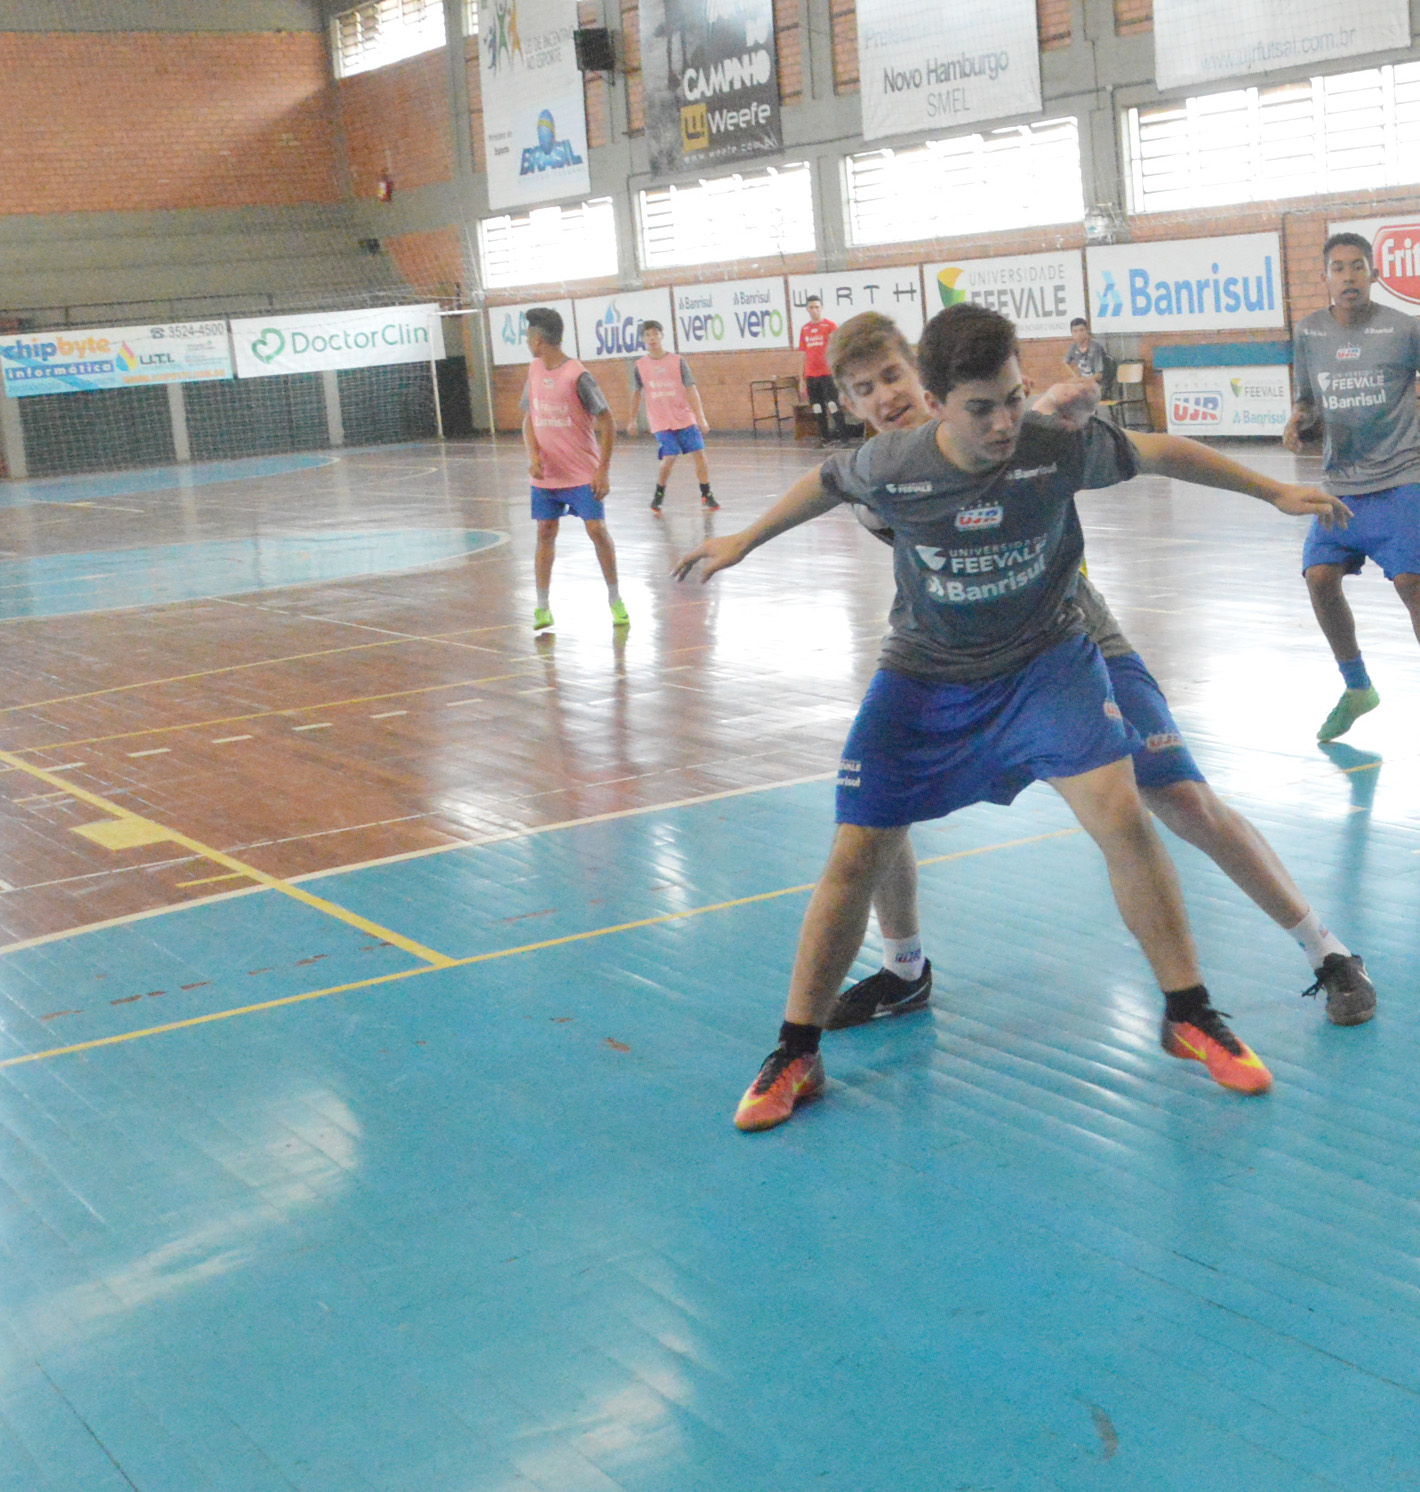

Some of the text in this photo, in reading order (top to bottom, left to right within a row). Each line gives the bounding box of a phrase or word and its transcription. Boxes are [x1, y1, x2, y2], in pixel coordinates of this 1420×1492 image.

[683, 49, 771, 101] CAMPINHO
[883, 50, 1010, 95] Novo Hamburgo
[926, 87, 971, 118] SMEL
[708, 102, 771, 135] Weefe
[969, 263, 1066, 287] UNIVERSIDADE
[1128, 255, 1275, 317] Banrisul
[685, 293, 713, 311] Banrisul
[738, 288, 771, 305] Banrisul
[970, 284, 1068, 320] FEEVALE
[167, 322, 225, 339] 3524-4500
[678, 312, 725, 342] vero
[733, 308, 784, 338] vero
[1, 336, 111, 362] chipbyte
[290, 322, 429, 355] DoctorClin
[7, 362, 112, 380] informática
[1331, 374, 1385, 391] FEEVALE
[1243, 385, 1285, 398] FEEVALE
[1328, 388, 1387, 410] Banrisul
[1173, 396, 1220, 422] UJR
[1242, 409, 1286, 424] Banrisul
[951, 539, 1048, 574] FEEVALE
[946, 556, 1046, 602] Banrisul
